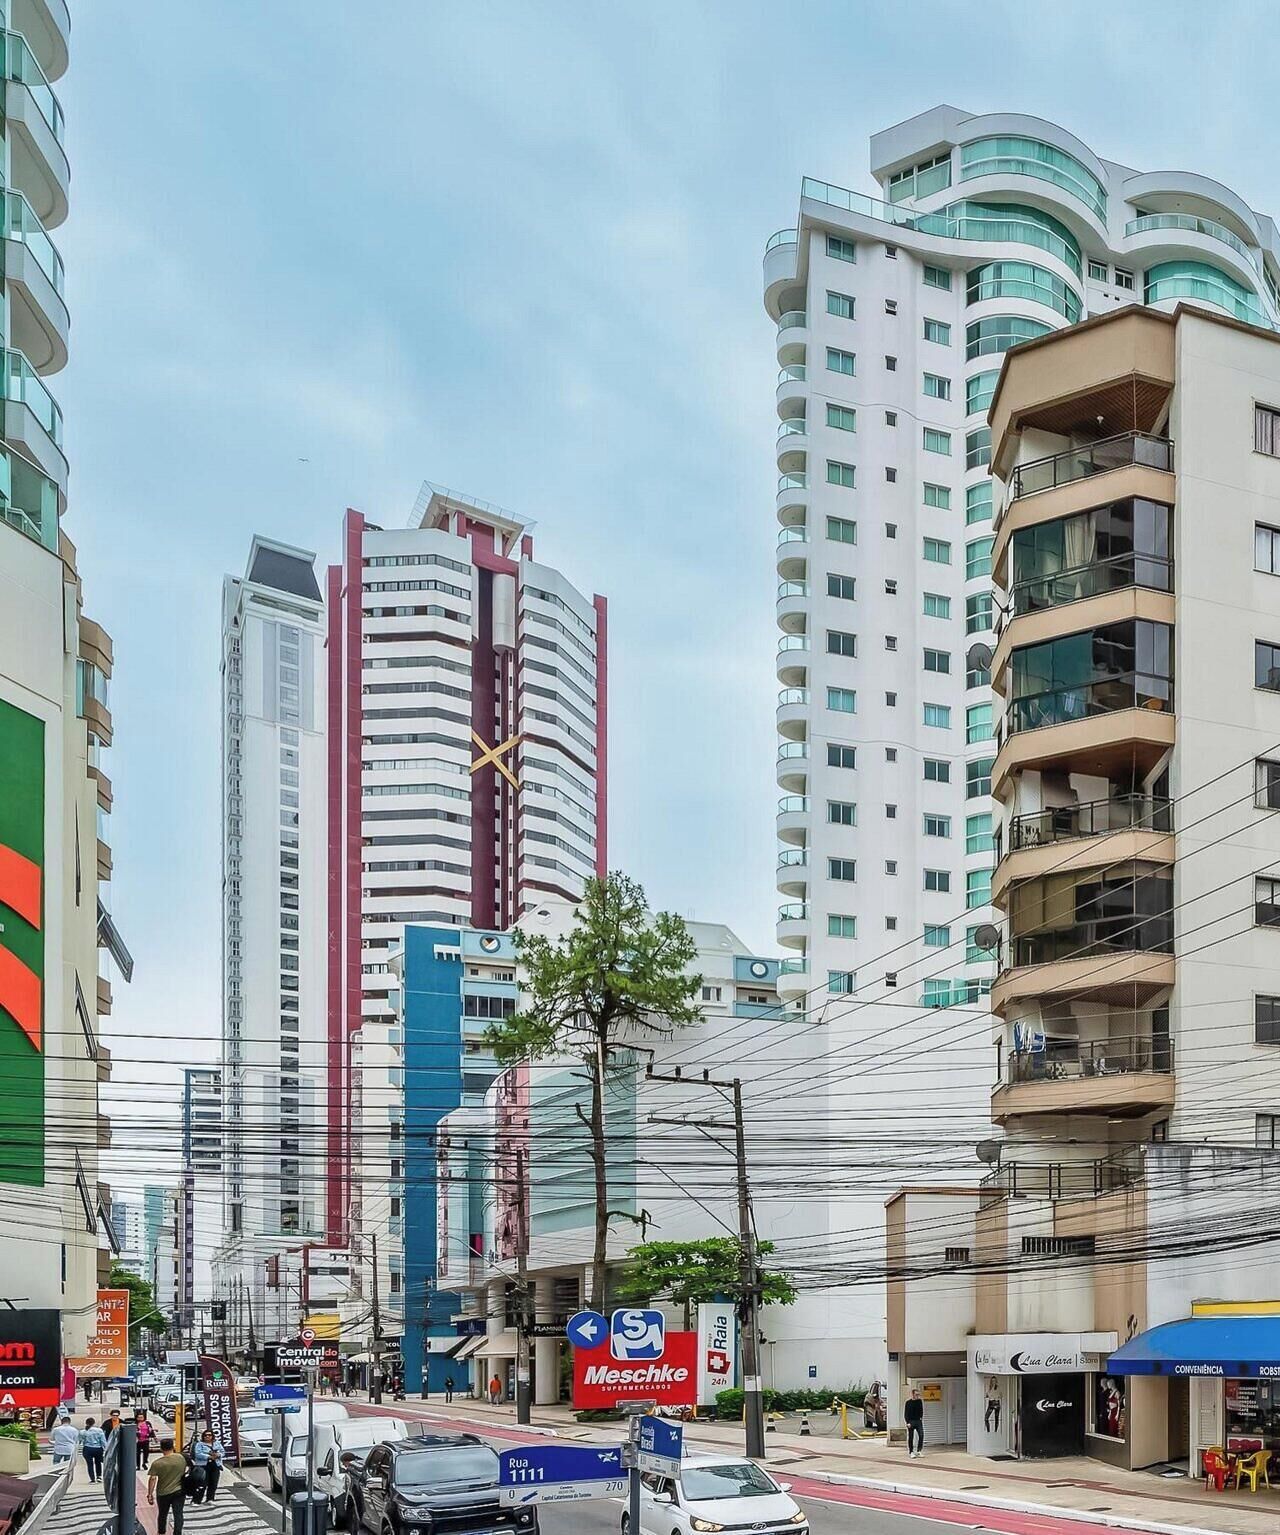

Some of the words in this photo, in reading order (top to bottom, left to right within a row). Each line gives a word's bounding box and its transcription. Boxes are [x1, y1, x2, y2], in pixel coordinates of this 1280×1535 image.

[713, 1315, 727, 1350] Raia
[277, 1346, 324, 1356] Central
[1020, 1355, 1042, 1366] Lua
[1044, 1354, 1072, 1367] Clara
[584, 1363, 689, 1385] Meschke
[1174, 1364, 1224, 1375] CONVENIÊNCIA
[206, 1379, 228, 1388] Rural
[711, 1378, 727, 1386] 24h
[601, 1384, 671, 1392] SUPERMERCADOS
[1056, 1400, 1073, 1409] Clara
[210, 1394, 222, 1440] ODUTOS
[221, 1395, 233, 1447] NATURAIS
[509, 1457, 529, 1469] Rua
[509, 1467, 544, 1482] 1111
[605, 1481, 623, 1491] 270
[508, 1489, 515, 1499] 0
